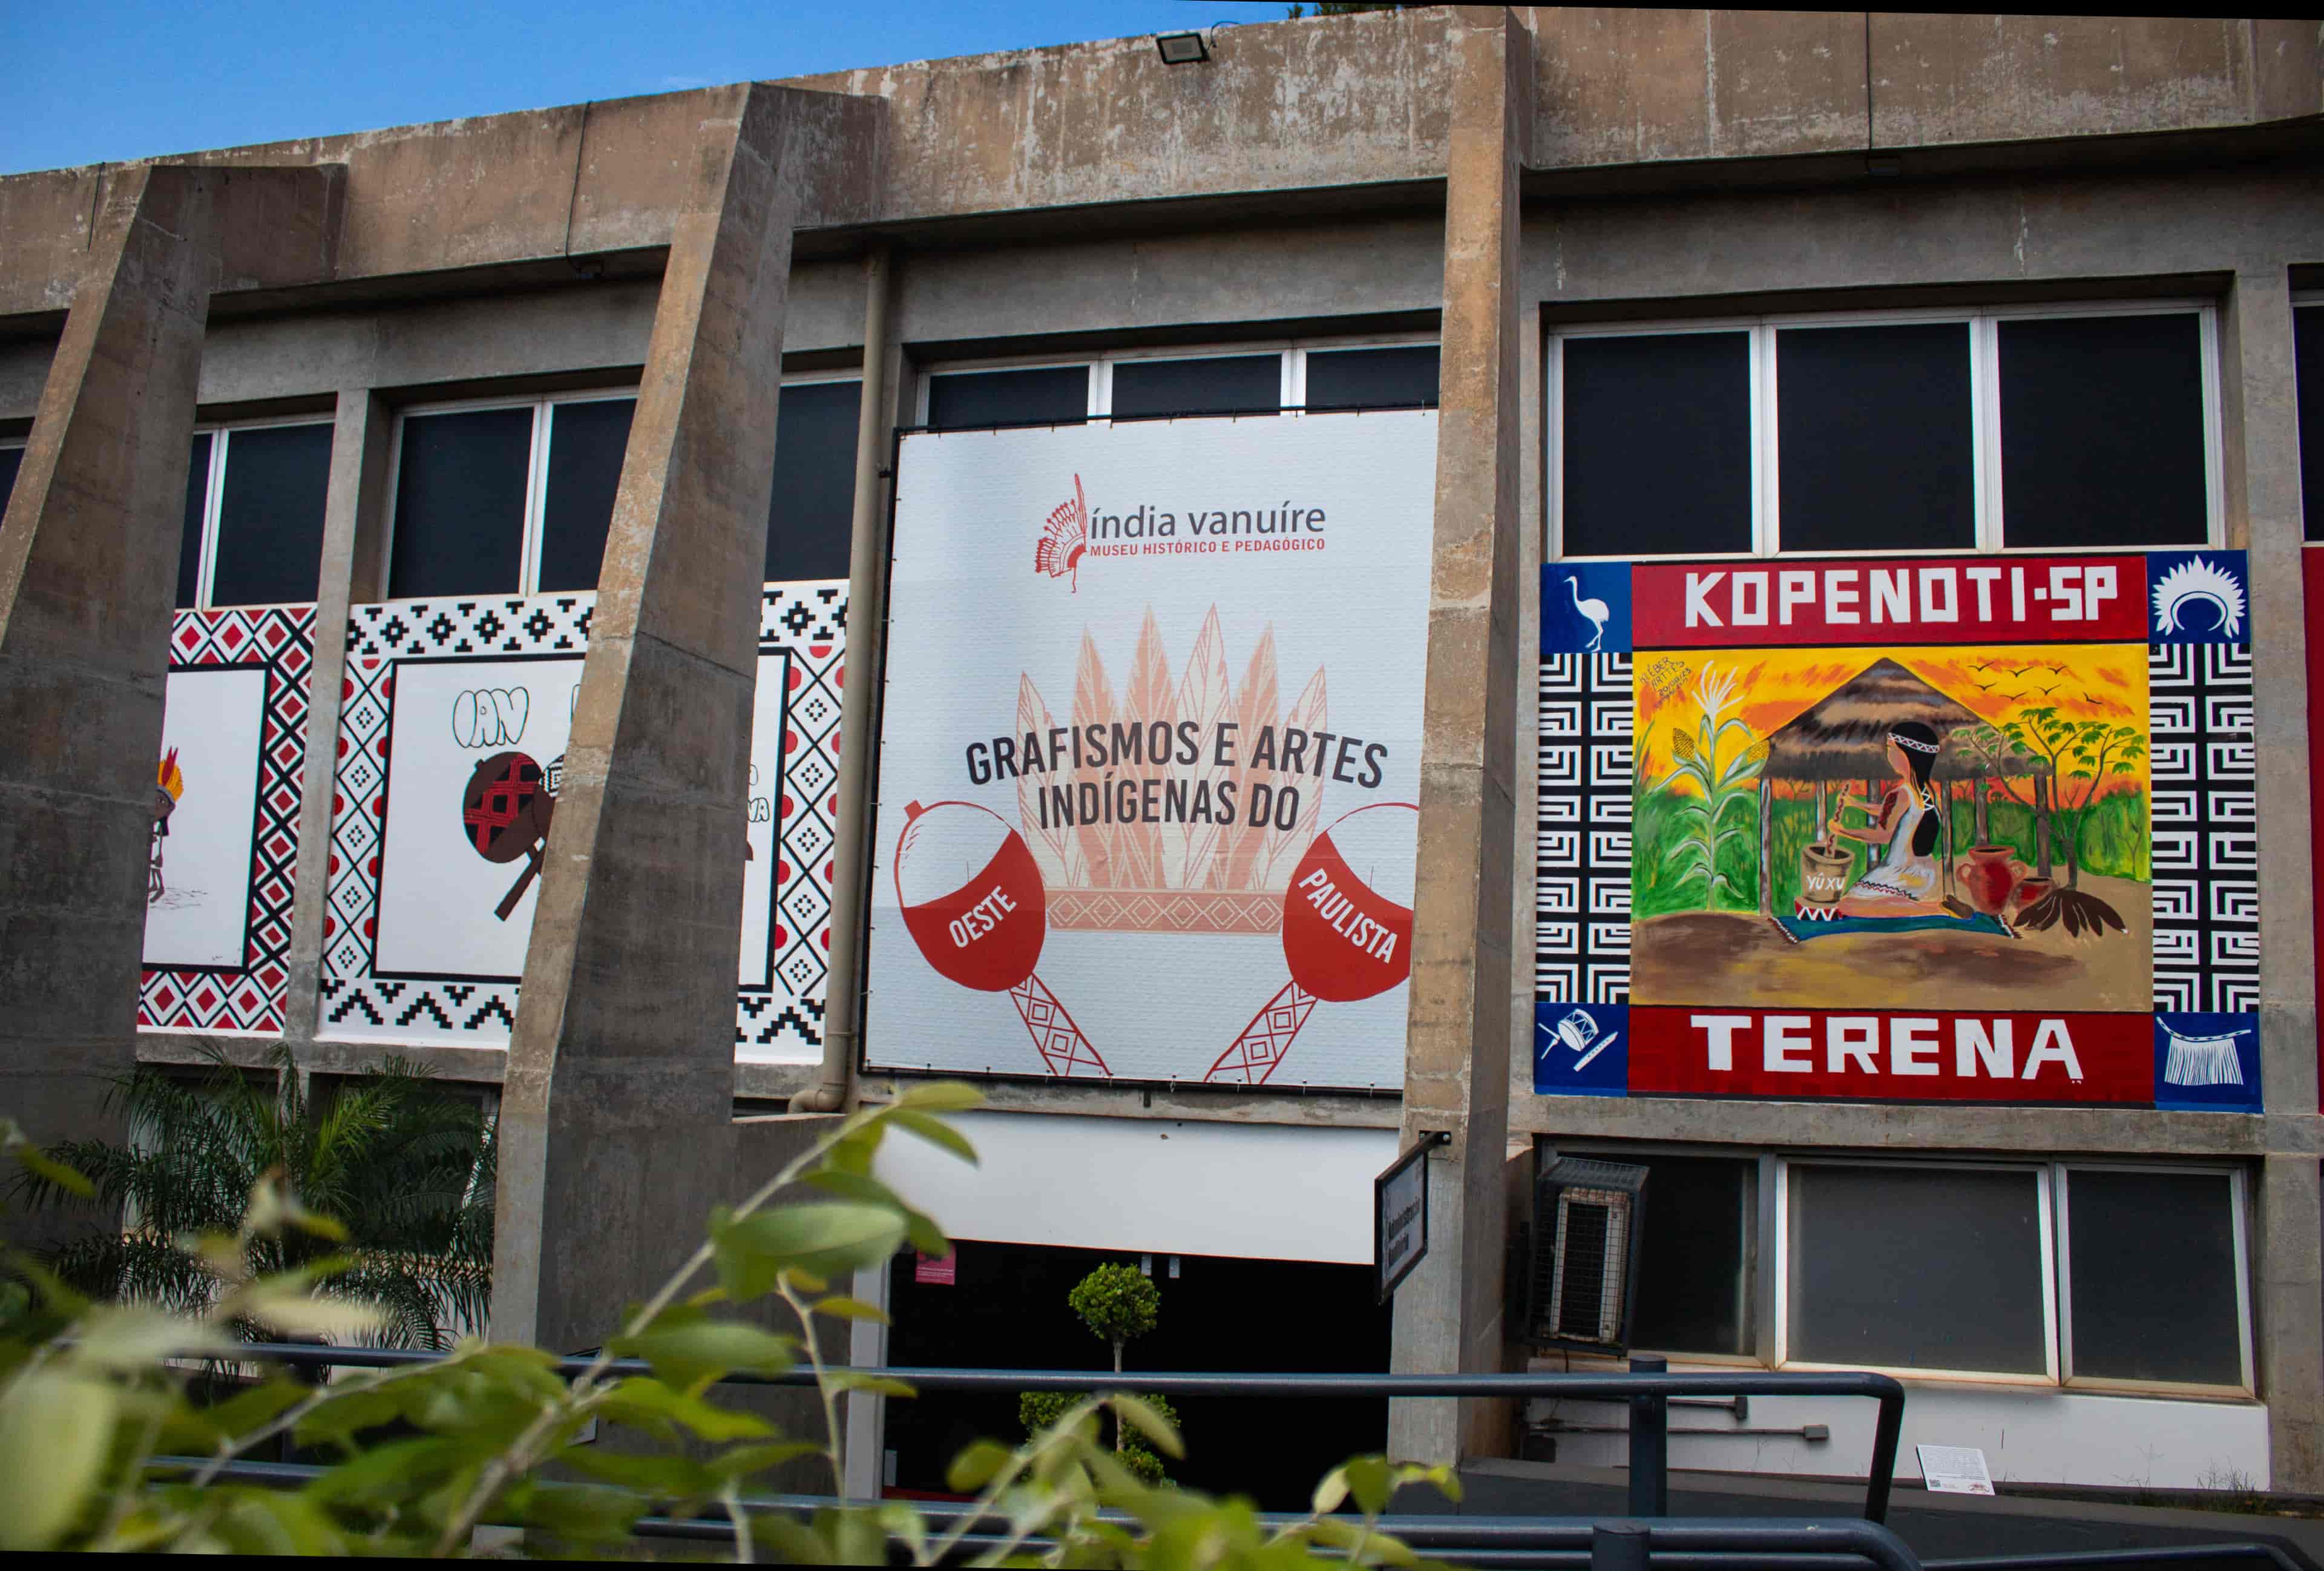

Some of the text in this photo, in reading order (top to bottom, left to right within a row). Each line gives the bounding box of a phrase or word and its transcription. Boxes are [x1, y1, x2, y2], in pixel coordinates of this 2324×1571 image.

[1091, 538, 1325, 557] MUSEU HISTÓRICO E PEDAGÓGICO
[1092, 500, 1325, 539] índia vanuíre
[967, 721, 1388, 789] GRAFISMOS E ARTES
[1039, 771, 1299, 831] INDÍGENAS DO
[948, 886, 1017, 949] OESTE
[1299, 868, 1397, 964] PAULISTA
[1691, 1015, 2083, 1079] TERENA
